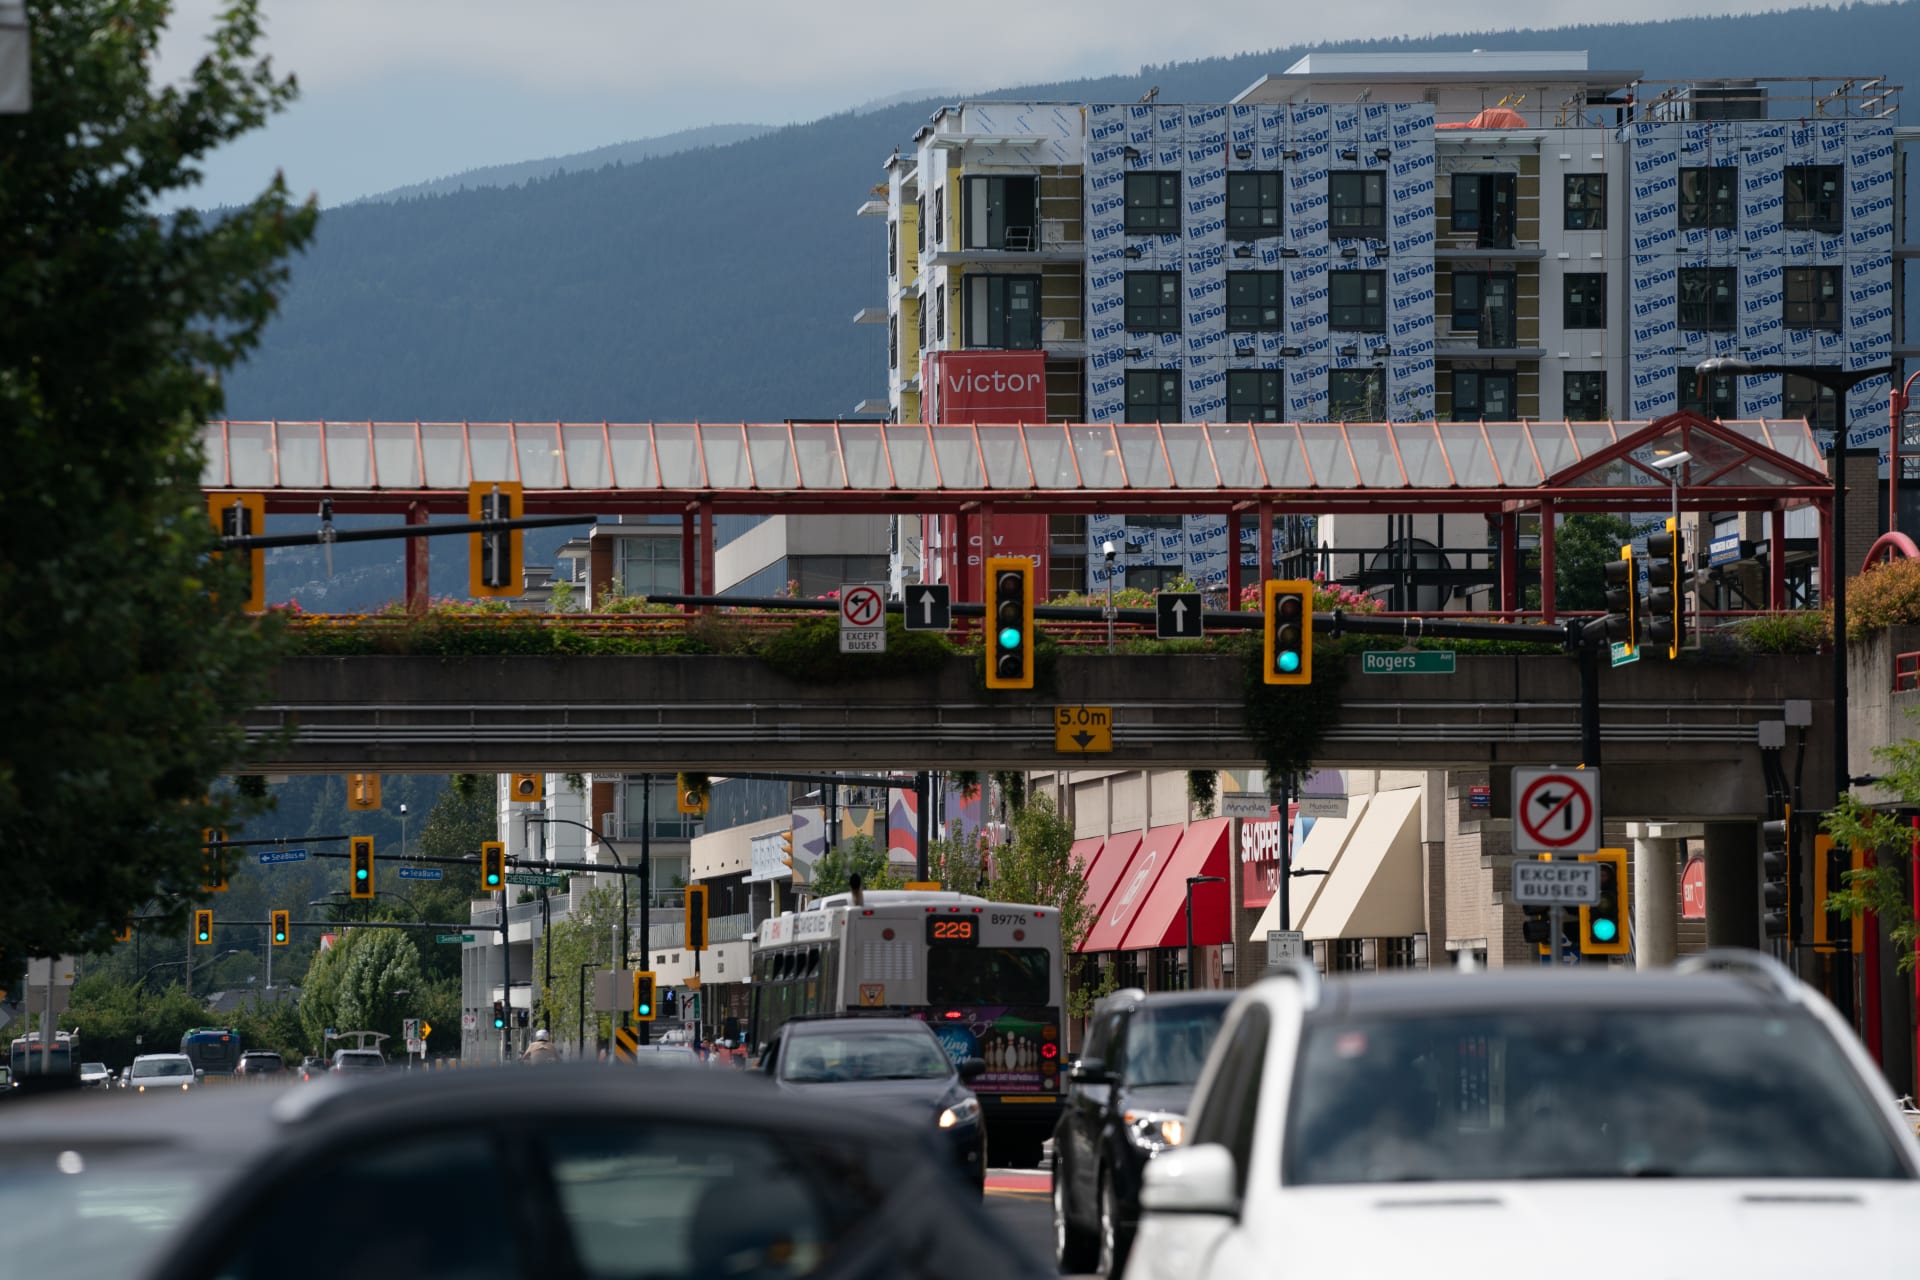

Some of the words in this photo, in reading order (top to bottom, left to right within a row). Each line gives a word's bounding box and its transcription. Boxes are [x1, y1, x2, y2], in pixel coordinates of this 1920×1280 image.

[1393, 116, 1434, 137] larson
[1393, 155, 1434, 176] larson
[1635, 151, 1676, 173] larson
[1851, 146, 1893, 166] larson
[1393, 181, 1434, 201] larson
[1635, 178, 1676, 200] larson
[1851, 171, 1893, 193] larson
[1393, 206, 1434, 228] larson
[1635, 202, 1676, 224] larson
[1851, 196, 1893, 218] larson
[1393, 232, 1433, 253] larson
[1635, 229, 1676, 251] larson
[1851, 223, 1893, 245] larson
[1393, 264, 1433, 285] larson
[1850, 255, 1892, 275] larson
[1635, 270, 1675, 291] larson
[1393, 290, 1433, 311] larson
[1850, 281, 1892, 302] larson
[1635, 295, 1675, 317] larson
[1393, 315, 1434, 336] larson
[1850, 306, 1892, 329] larson
[1635, 321, 1675, 342] larson
[1393, 359, 1434, 380] larson
[1634, 366, 1675, 386] larson
[949, 367, 1041, 394] victor
[1634, 391, 1675, 413] larson
[845, 632, 881, 642] EXCEPT
[848, 641, 878, 651] BUSES
[1366, 652, 1418, 671] Rogers
[1059, 708, 1108, 727] 5.0m
[1241, 821, 1281, 863] SHOPPE
[1519, 868, 1592, 882] EXCEPT
[1523, 883, 1589, 898] BUSES
[991, 913, 1027, 926] B9776
[933, 921, 973, 940] 229
